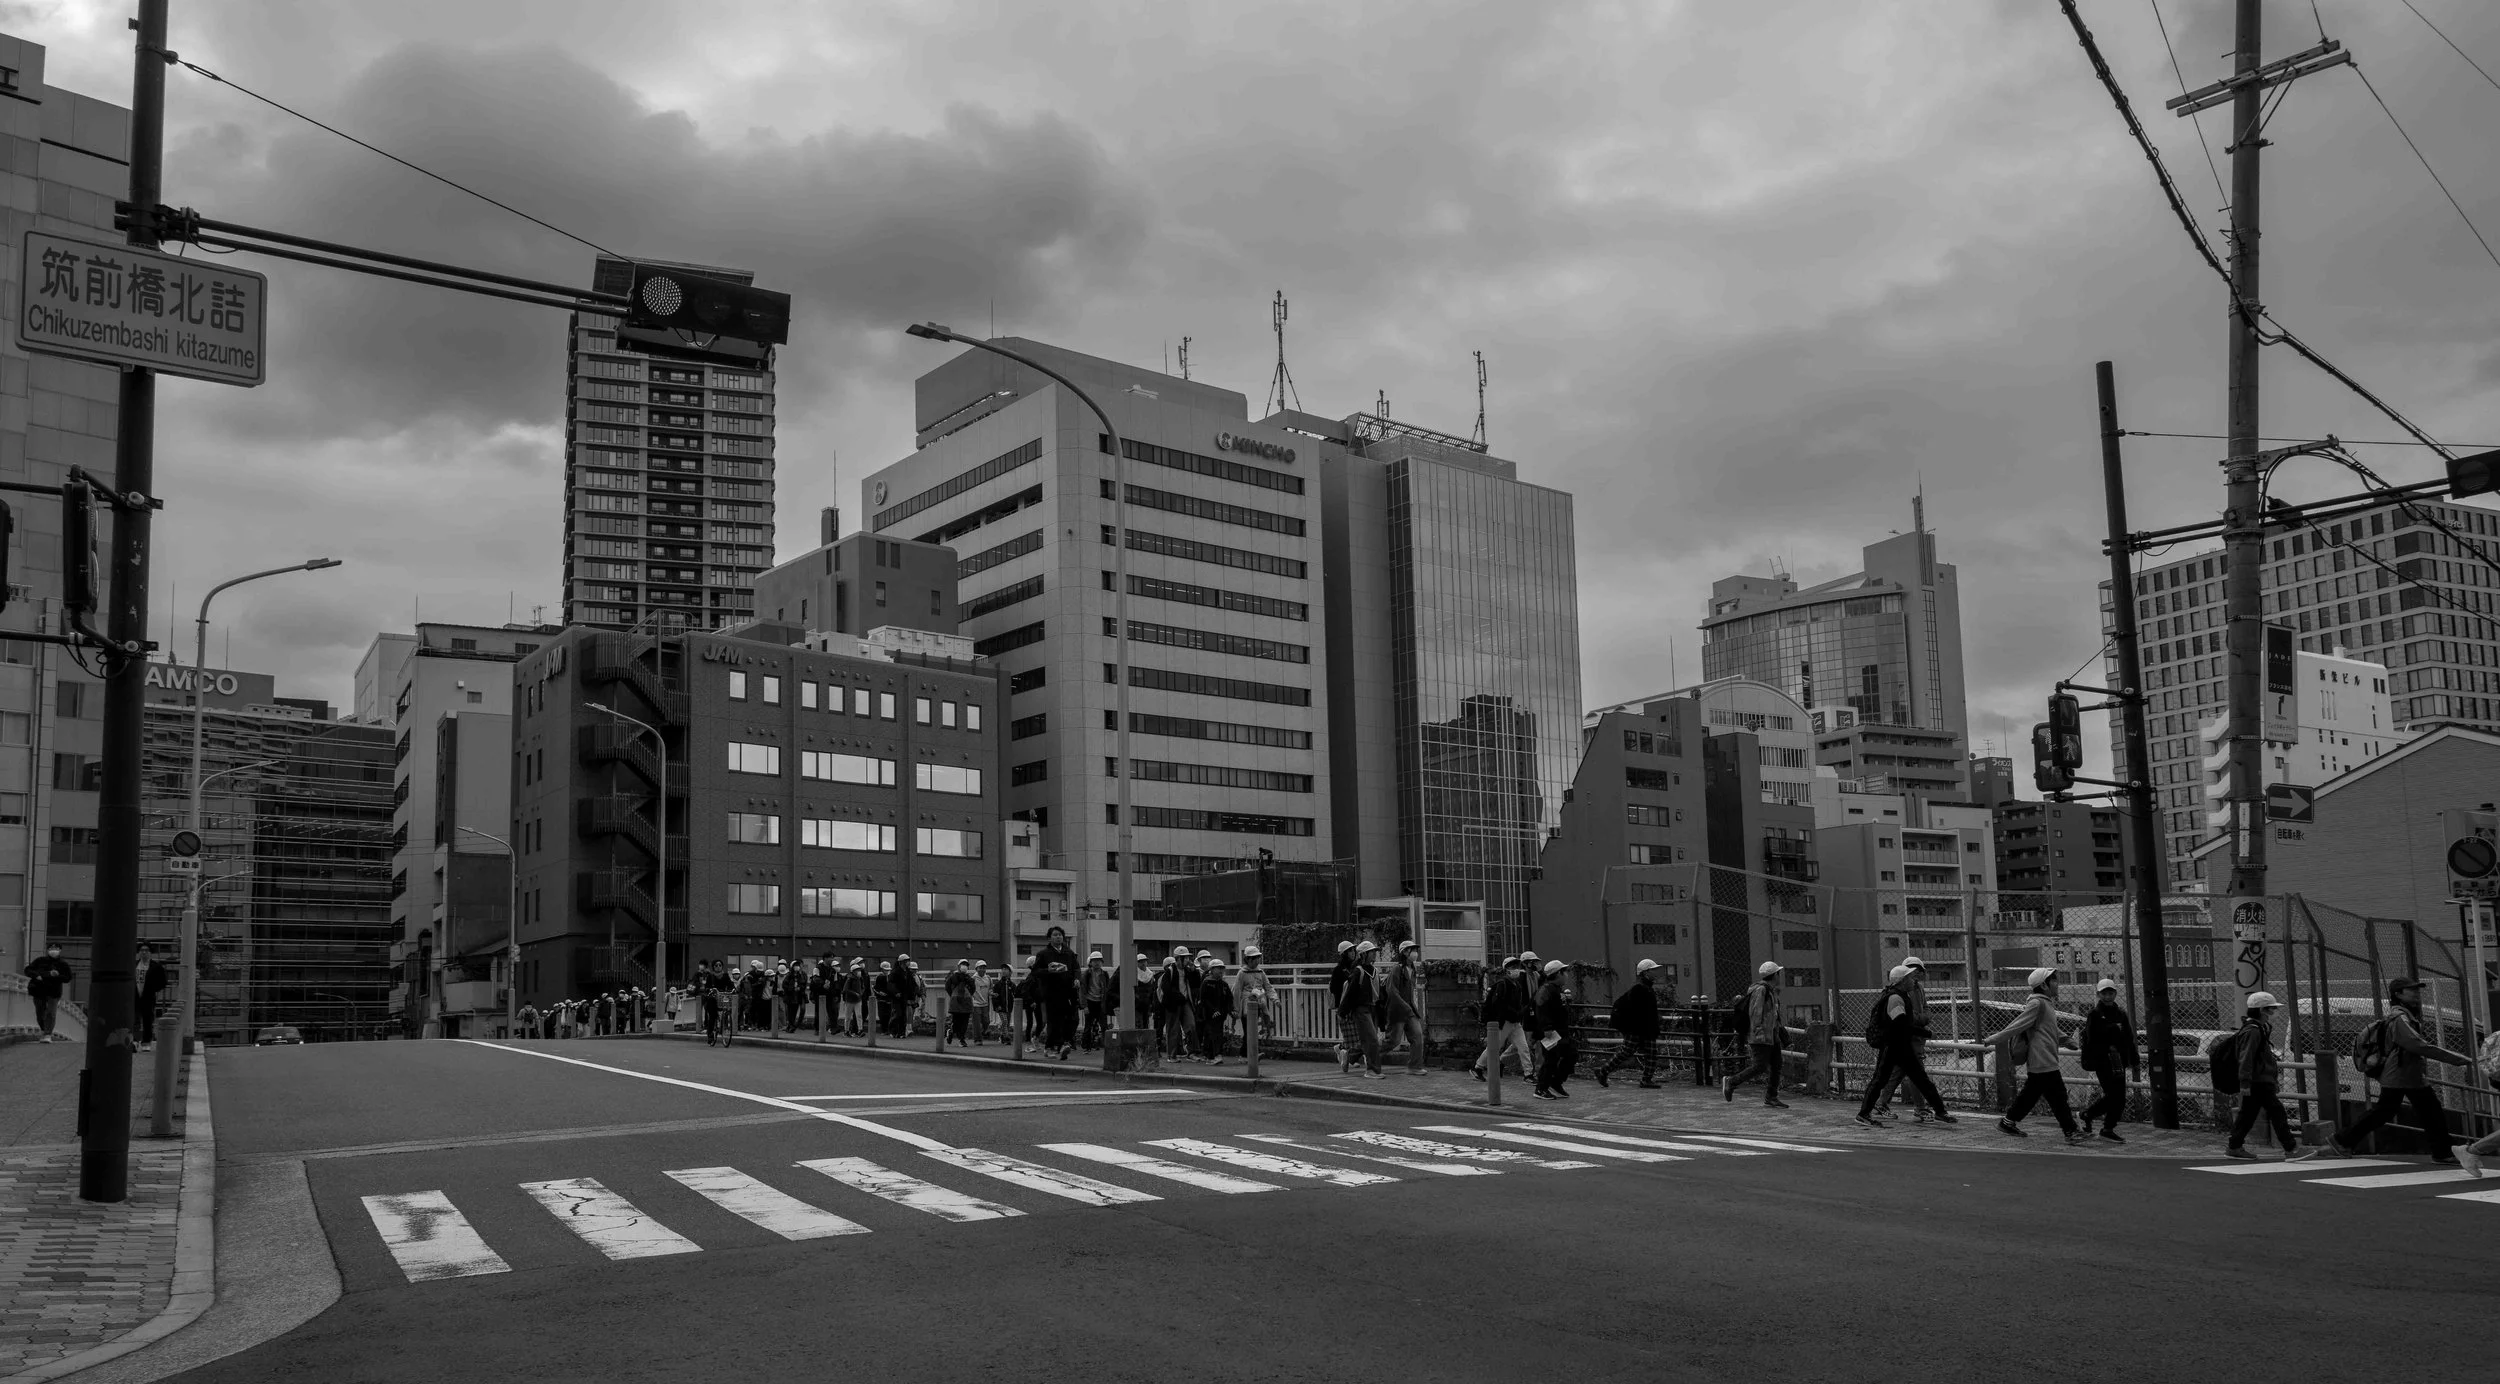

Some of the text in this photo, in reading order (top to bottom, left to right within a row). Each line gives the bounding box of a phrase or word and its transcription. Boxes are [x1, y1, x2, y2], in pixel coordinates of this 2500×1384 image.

[39, 247, 246, 333] 筑前橋北詰
[28, 304, 255, 369] Chikuzembashi kitazume
[704, 644, 743, 664] JAM
